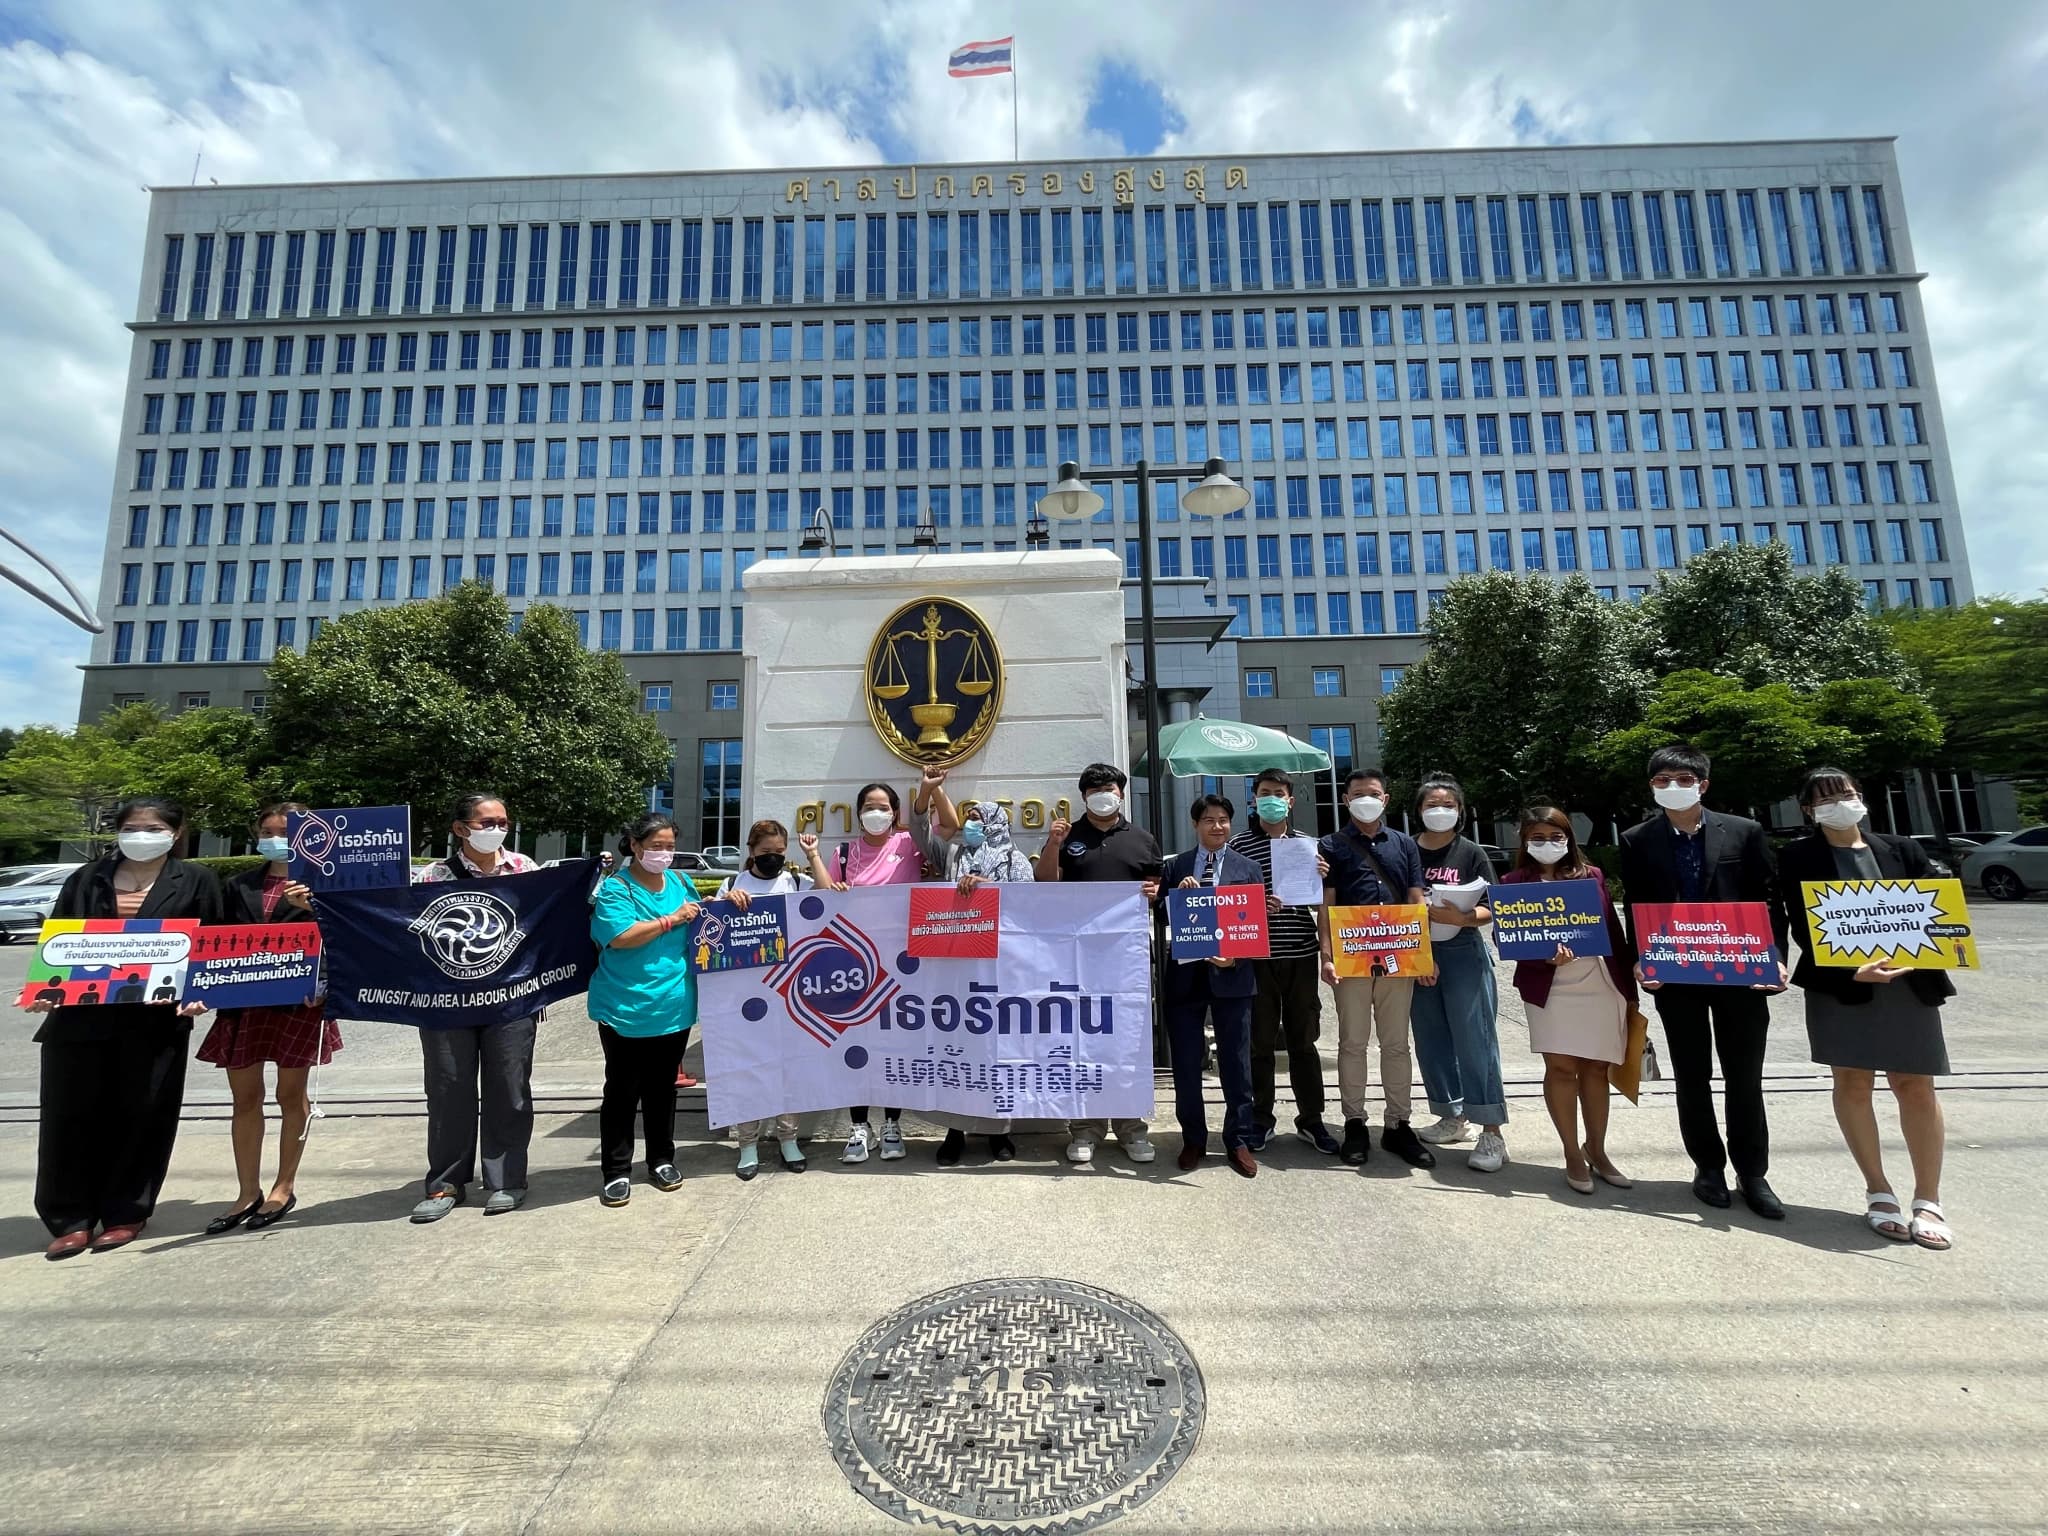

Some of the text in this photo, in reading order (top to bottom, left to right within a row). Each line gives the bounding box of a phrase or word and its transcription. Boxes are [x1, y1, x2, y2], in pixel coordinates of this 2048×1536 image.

[786, 165, 1249, 205] ศาลปกครองสูงสุด
[304, 832, 327, 847] ม.33
[338, 828, 403, 848] เธอรักกัน
[340, 847, 401, 867] แต่ฉันถูกลืม
[1186, 894, 1248, 908] SECTION 33
[1494, 896, 1566, 915] Section 33
[1826, 899, 1925, 920] แรงงานทั้งผอง
[730, 911, 777, 928] เรารักกัน
[1496, 912, 1601, 929] You Love Each Other
[1673, 920, 1727, 932] ใครบอกว่า
[1836, 918, 1921, 936] เป็นพี่น้องกัน
[1238, 932, 1258, 940] LOVED
[1338, 921, 1421, 938] แรงงานข้ามชาติ
[1499, 931, 1516, 943] But
[1517, 931, 1522, 942] I
[1523, 930, 1541, 941] Am
[1647, 932, 1761, 945] เลือดกรรมกรสีเดียวกัน
[206, 950, 304, 969] แรงงานไร้สัญชาติ
[1644, 947, 1770, 964] วันนี้พิสูจน์ได้แล้วว่าต่างสี
[358, 963, 577, 1008] RUNGSIT AND AREA LABOUR UNION GROUP
[801, 967, 865, 996] ม.33
[879, 981, 1114, 1035] เธอรักกัน
[885, 1044, 1104, 1113] แต่ฉันถูกลืม
